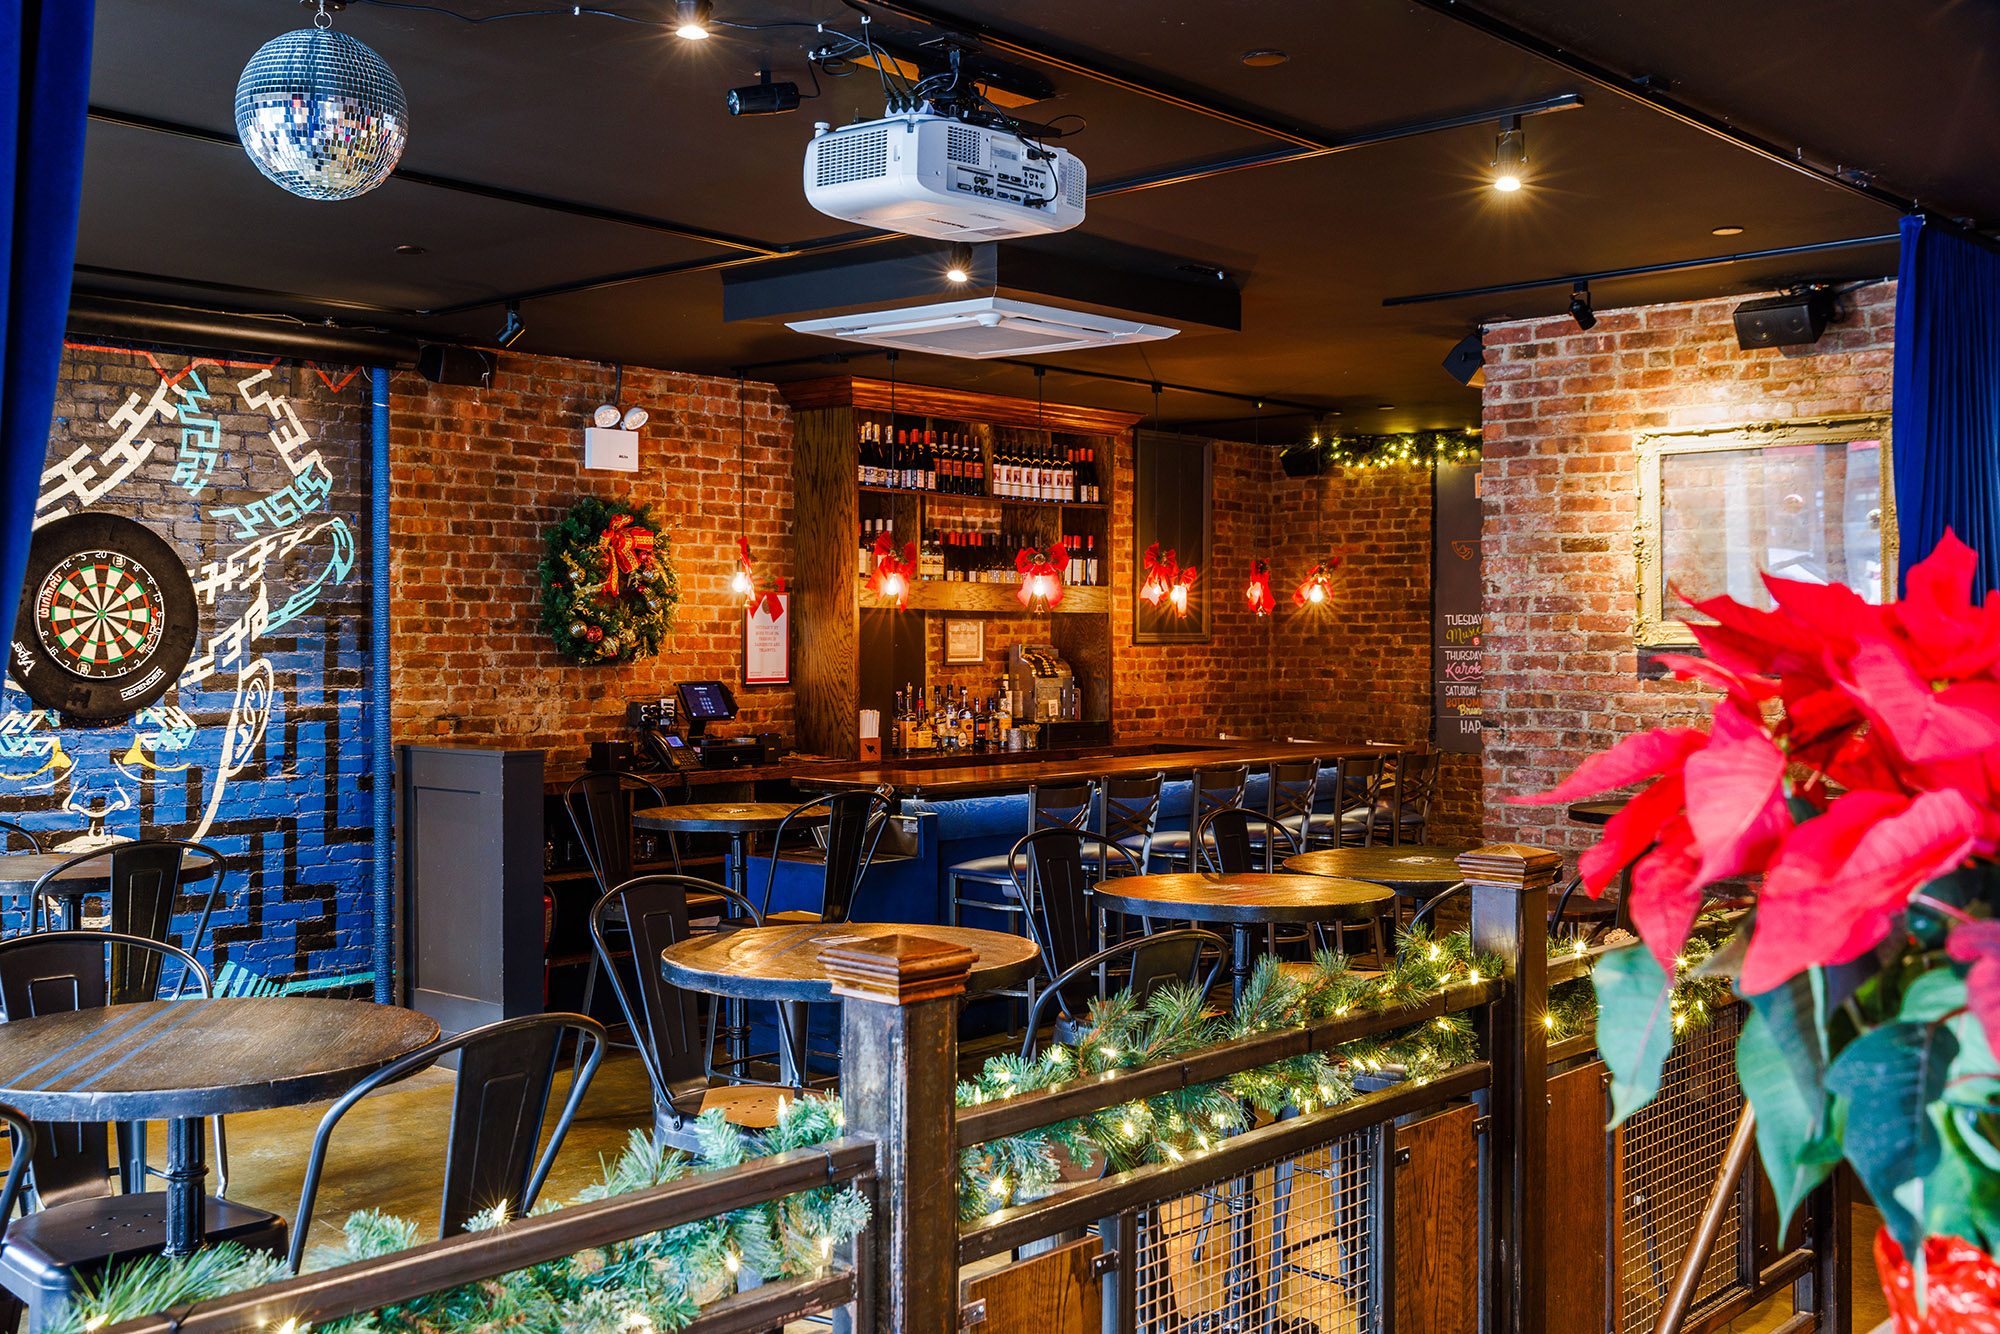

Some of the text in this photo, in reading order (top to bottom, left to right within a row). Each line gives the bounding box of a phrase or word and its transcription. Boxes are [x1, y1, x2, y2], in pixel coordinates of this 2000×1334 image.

[95, 551, 107, 559] 20
[62, 558, 72, 571] 12
[132, 563, 142, 572] 18
[147, 577, 154, 585] 4
[1444, 613, 1484, 626] TUESDAY
[40, 630, 49, 638] 8
[1446, 625, 1483, 645] Music
[49, 645, 59, 656] 16
[1444, 650, 1483, 661] THURSDAY
[10, 640, 36, 677] Viper
[117, 666, 127, 675] 17
[121, 668, 163, 698] DEFENDER
[1457, 703, 1483, 716] Brun
[1460, 719, 1481, 734] HAP
